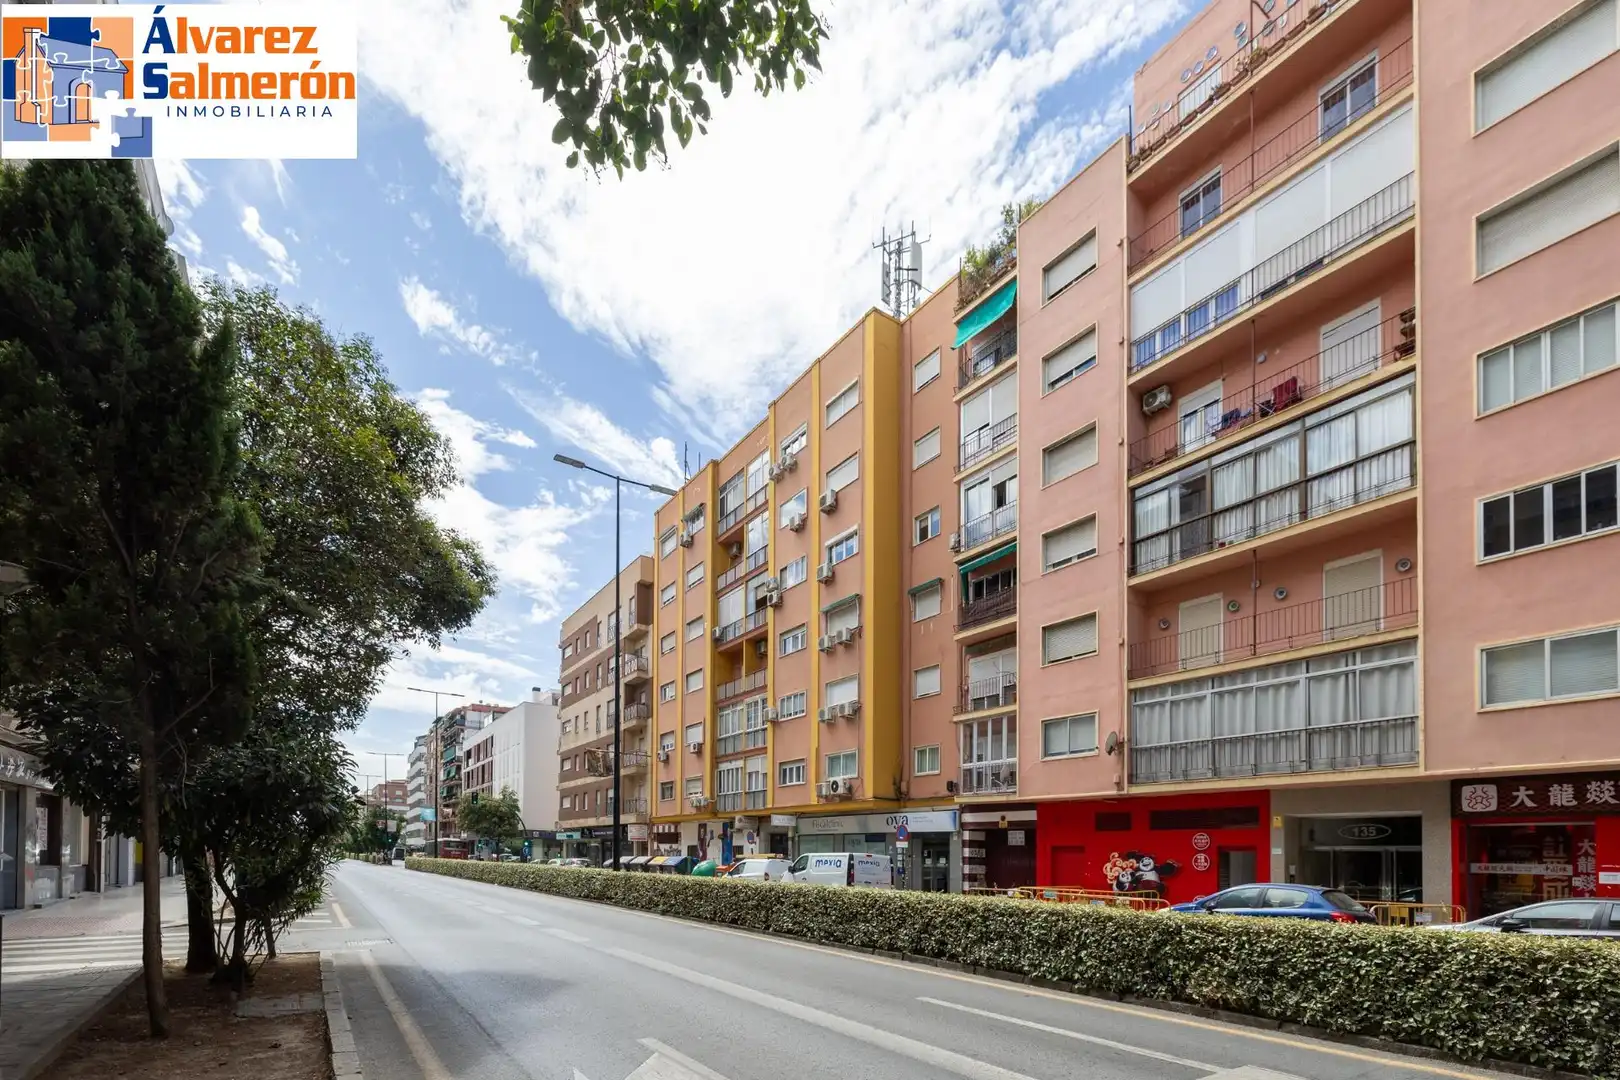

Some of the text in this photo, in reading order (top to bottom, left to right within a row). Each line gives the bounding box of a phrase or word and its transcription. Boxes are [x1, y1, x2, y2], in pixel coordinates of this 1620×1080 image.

[1510, 780, 1620, 807] 大龍燚
[1352, 827, 1376, 837] 135
[1576, 838, 1597, 898] 大龍燚
